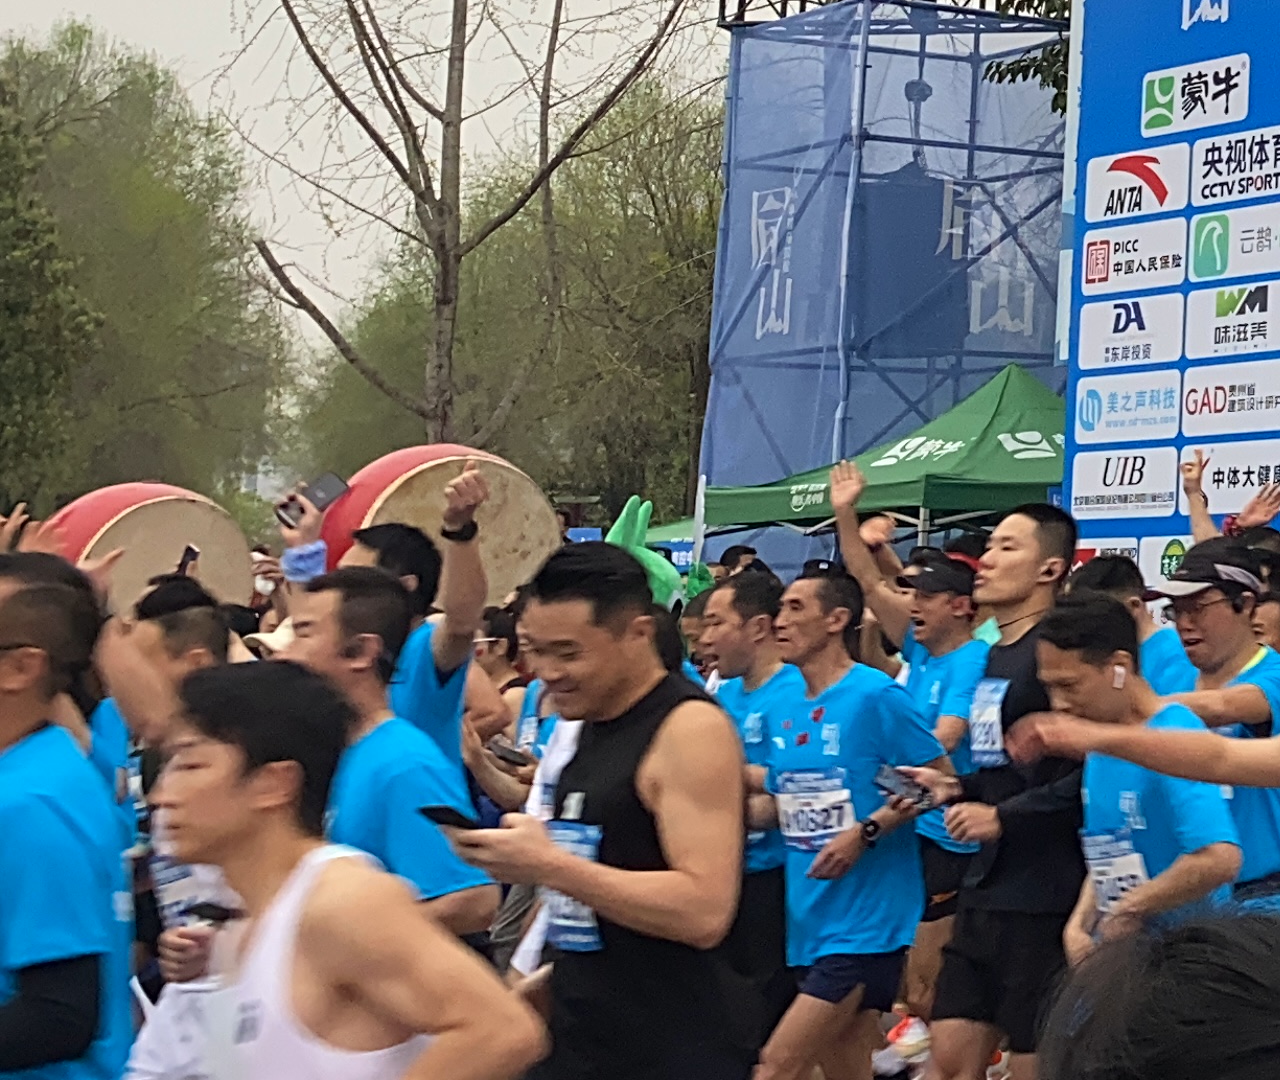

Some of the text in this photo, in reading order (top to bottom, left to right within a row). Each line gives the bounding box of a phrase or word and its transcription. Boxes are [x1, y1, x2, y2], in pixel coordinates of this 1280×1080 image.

[1181, 66, 1241, 120] 蒙牛
[1104, 186, 1142, 216] ANTA
[1201, 179, 1235, 200] CCTV
[1113, 239, 1140, 254] PICC
[1113, 253, 1183, 277] 中国人民保险
[1214, 321, 1268, 345] 味滋美
[1106, 387, 1176, 414] 美之声科技
[1185, 386, 1227, 416] GAD
[1102, 455, 1147, 488] UIB
